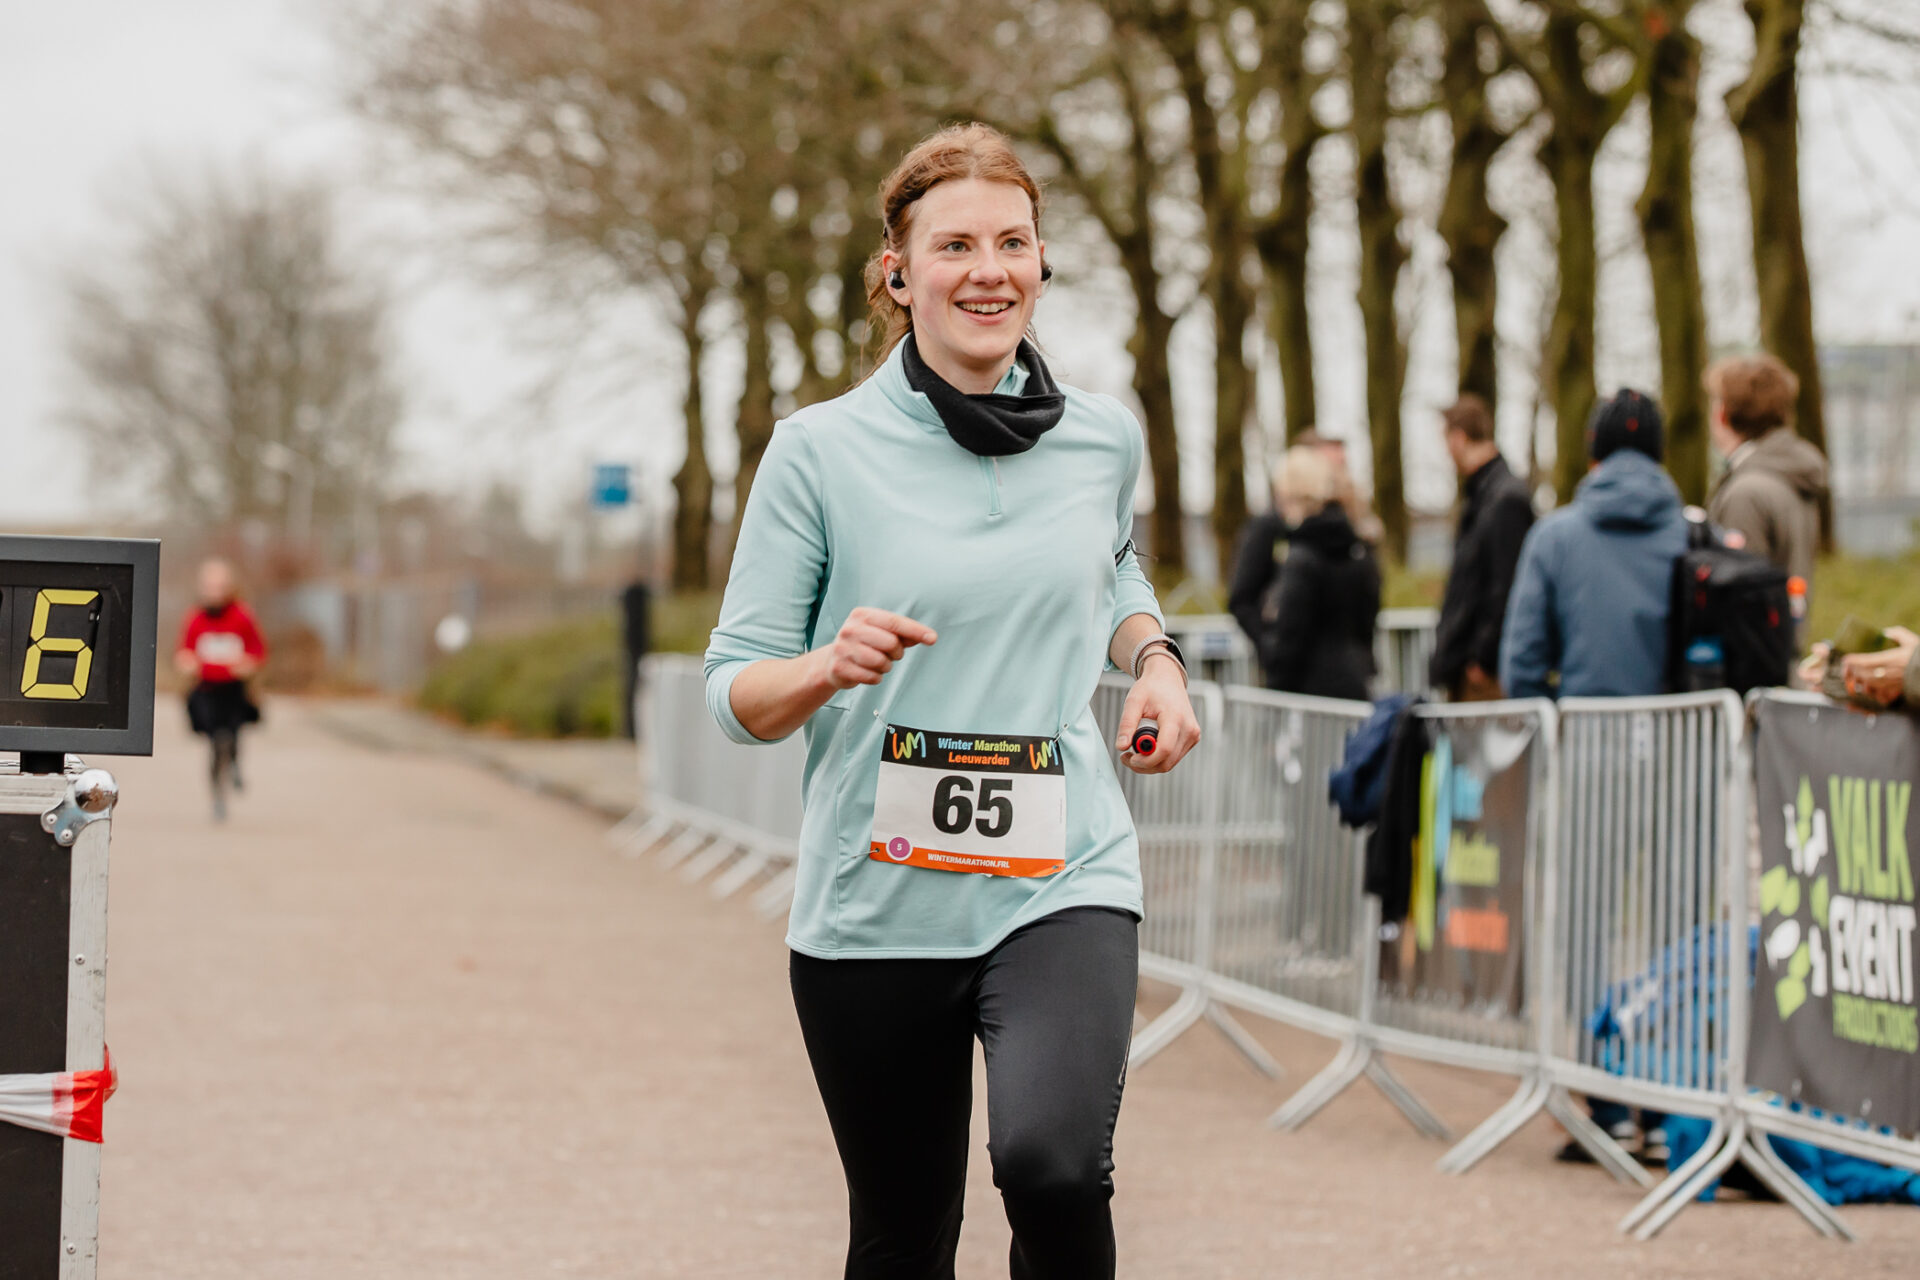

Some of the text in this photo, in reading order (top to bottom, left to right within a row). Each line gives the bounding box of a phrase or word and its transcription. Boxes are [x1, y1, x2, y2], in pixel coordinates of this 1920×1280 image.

[20, 588, 100, 700] 6
[937, 737, 1021, 753] Winter Marathon
[948, 752, 1010, 766] Leeuwarden
[932, 775, 1013, 838] 65
[1828, 774, 1914, 902] VALK
[927, 853, 1010, 869] WINTERMARATHON.FRL
[1829, 895, 1916, 1004] EVENT
